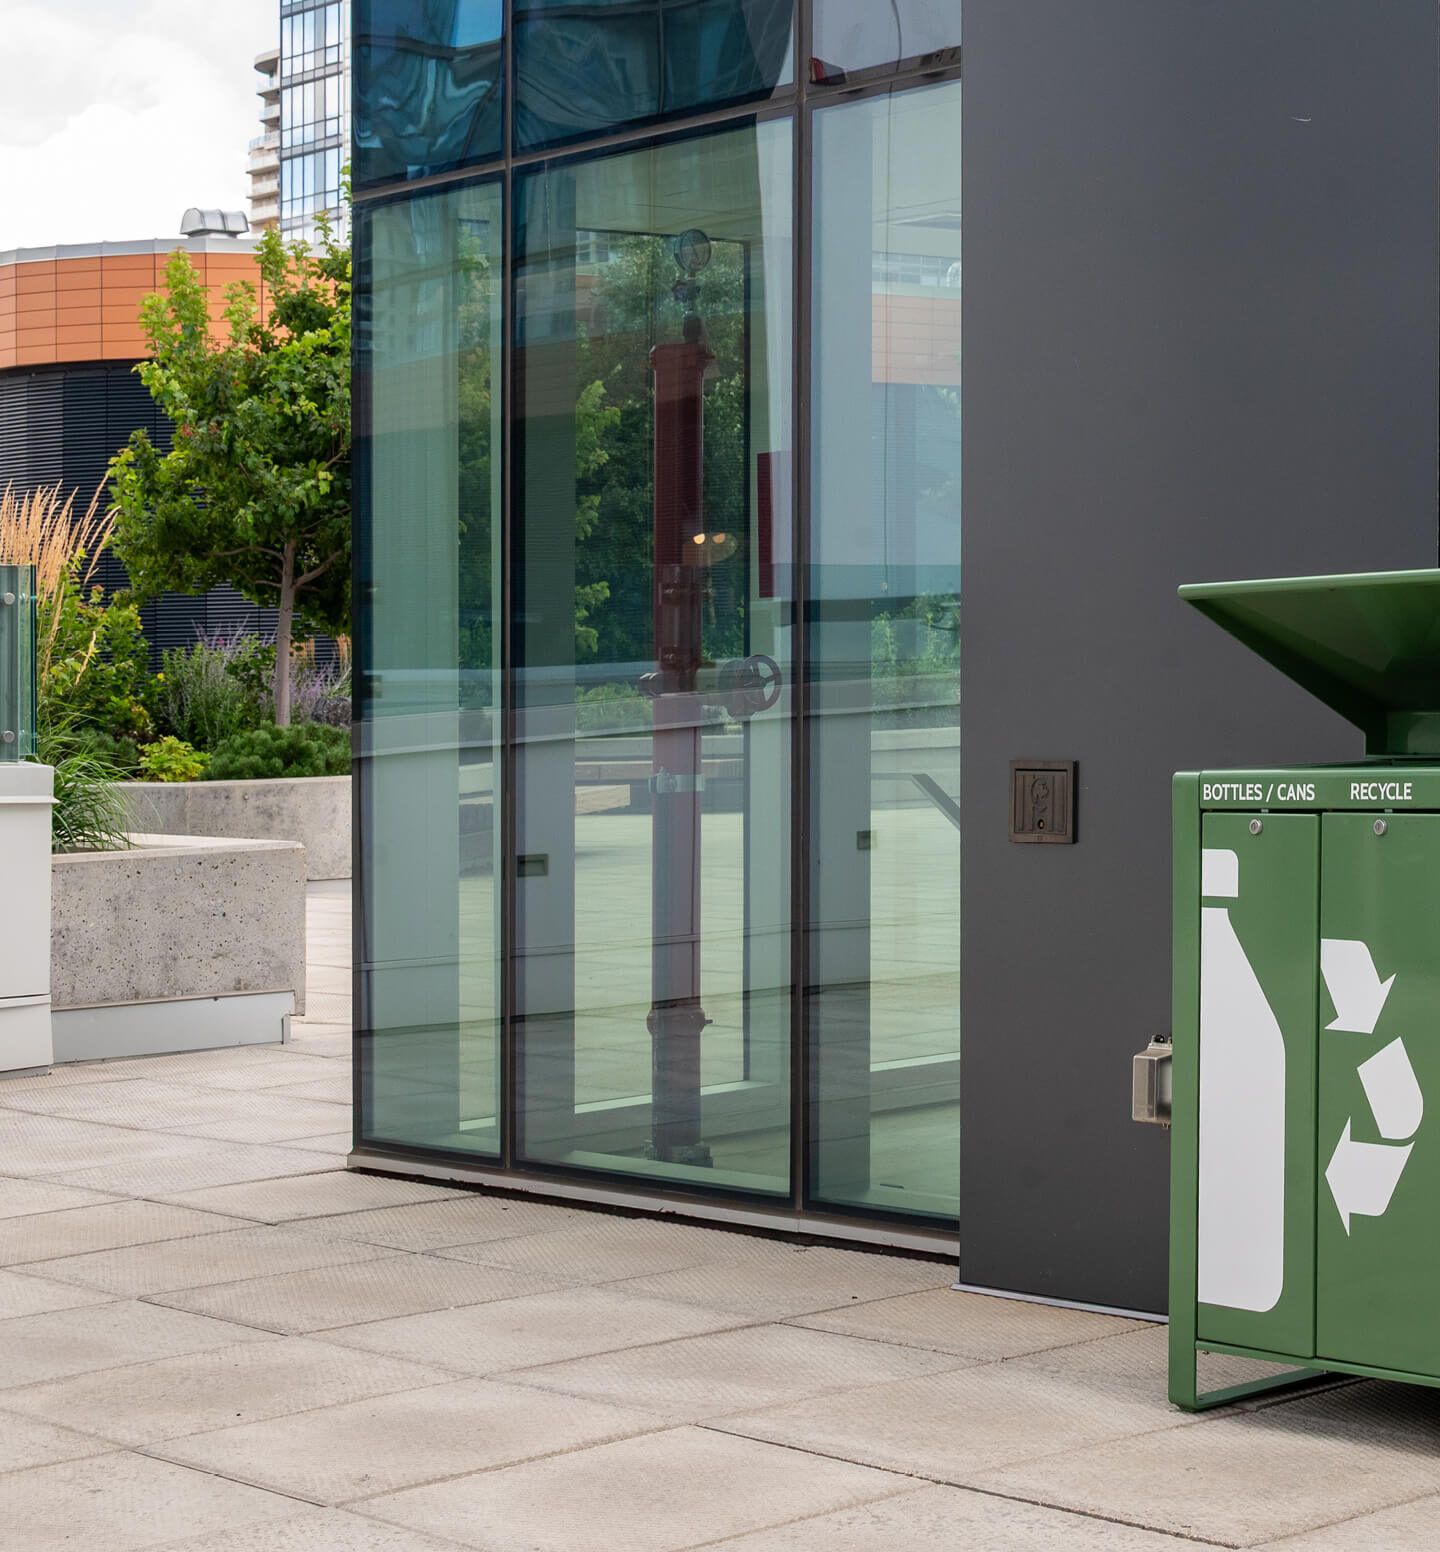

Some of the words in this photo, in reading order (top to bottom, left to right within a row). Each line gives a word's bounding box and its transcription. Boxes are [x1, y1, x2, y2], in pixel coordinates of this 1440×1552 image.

[1203, 783, 1263, 801] BOTTLES
[1266, 783, 1274, 803] /
[1276, 783, 1316, 801] CANS
[1350, 782, 1413, 801] RECYCLE
